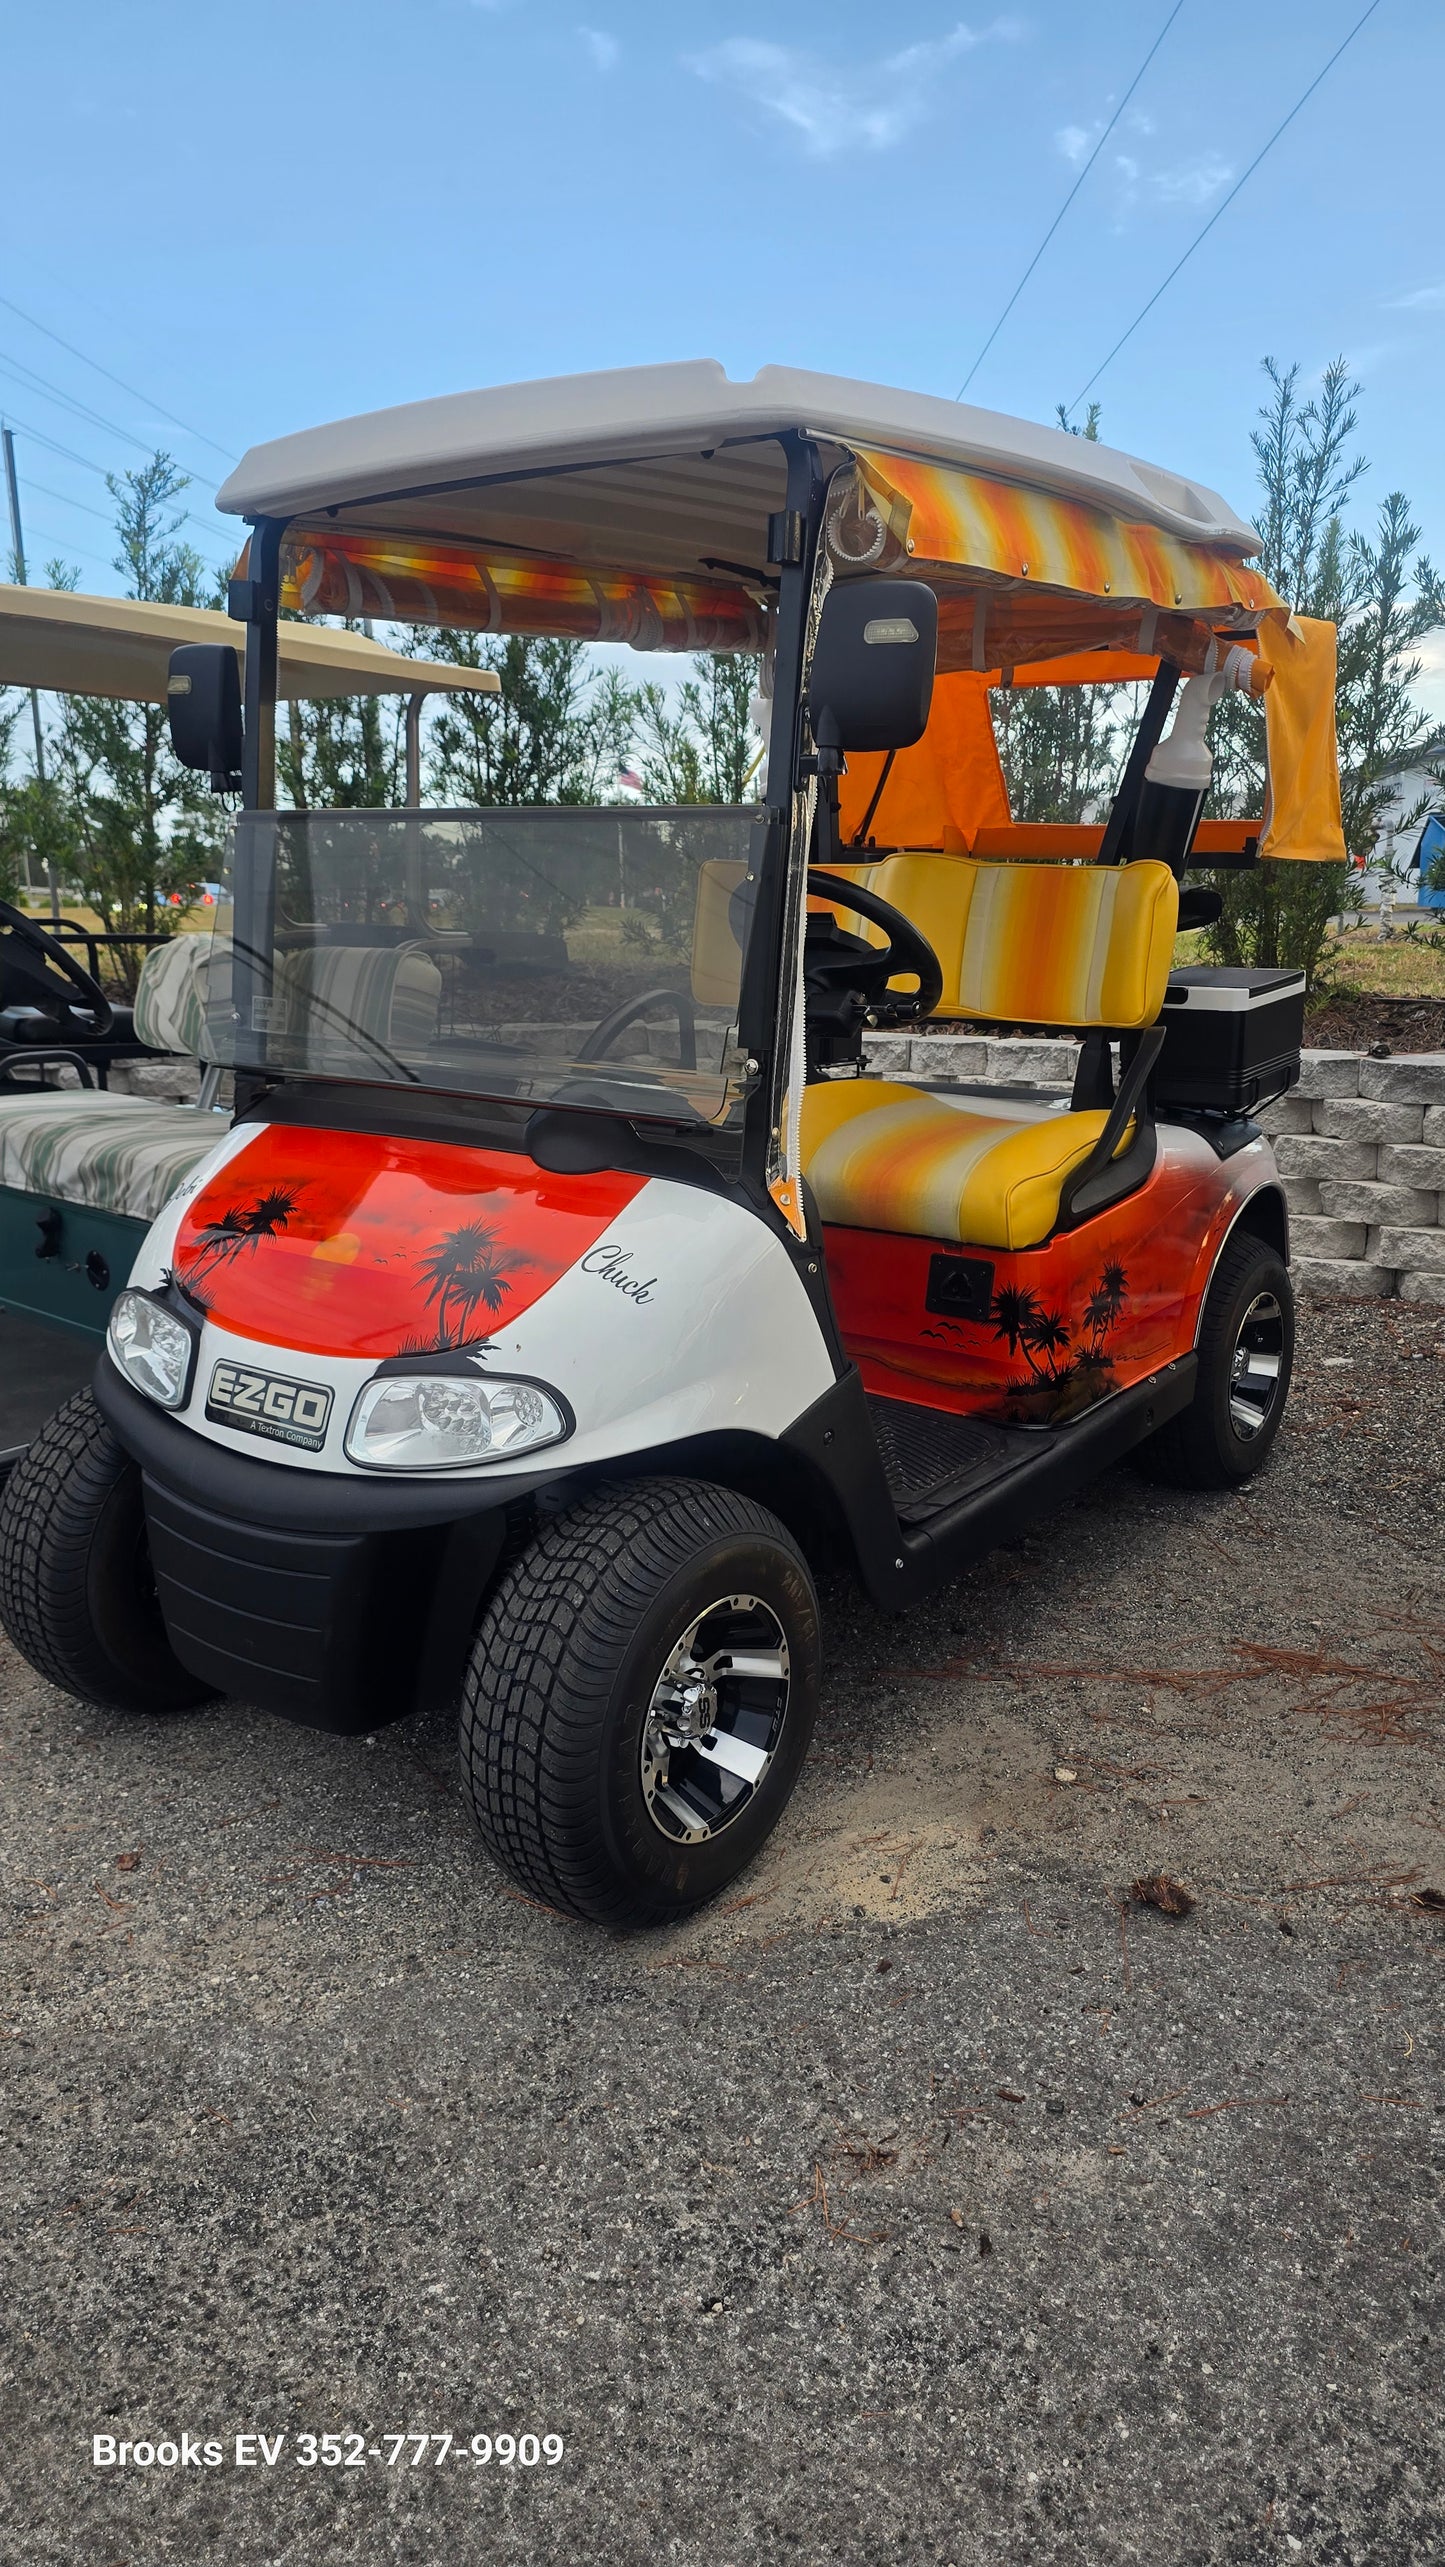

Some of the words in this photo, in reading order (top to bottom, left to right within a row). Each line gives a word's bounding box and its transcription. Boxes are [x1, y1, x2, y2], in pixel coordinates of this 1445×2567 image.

[581, 1245, 658, 1305] Chuck
[250, 1420, 256, 1429] A
[258, 1422, 285, 1439] Textron
[286, 1430, 323, 1450] Company
